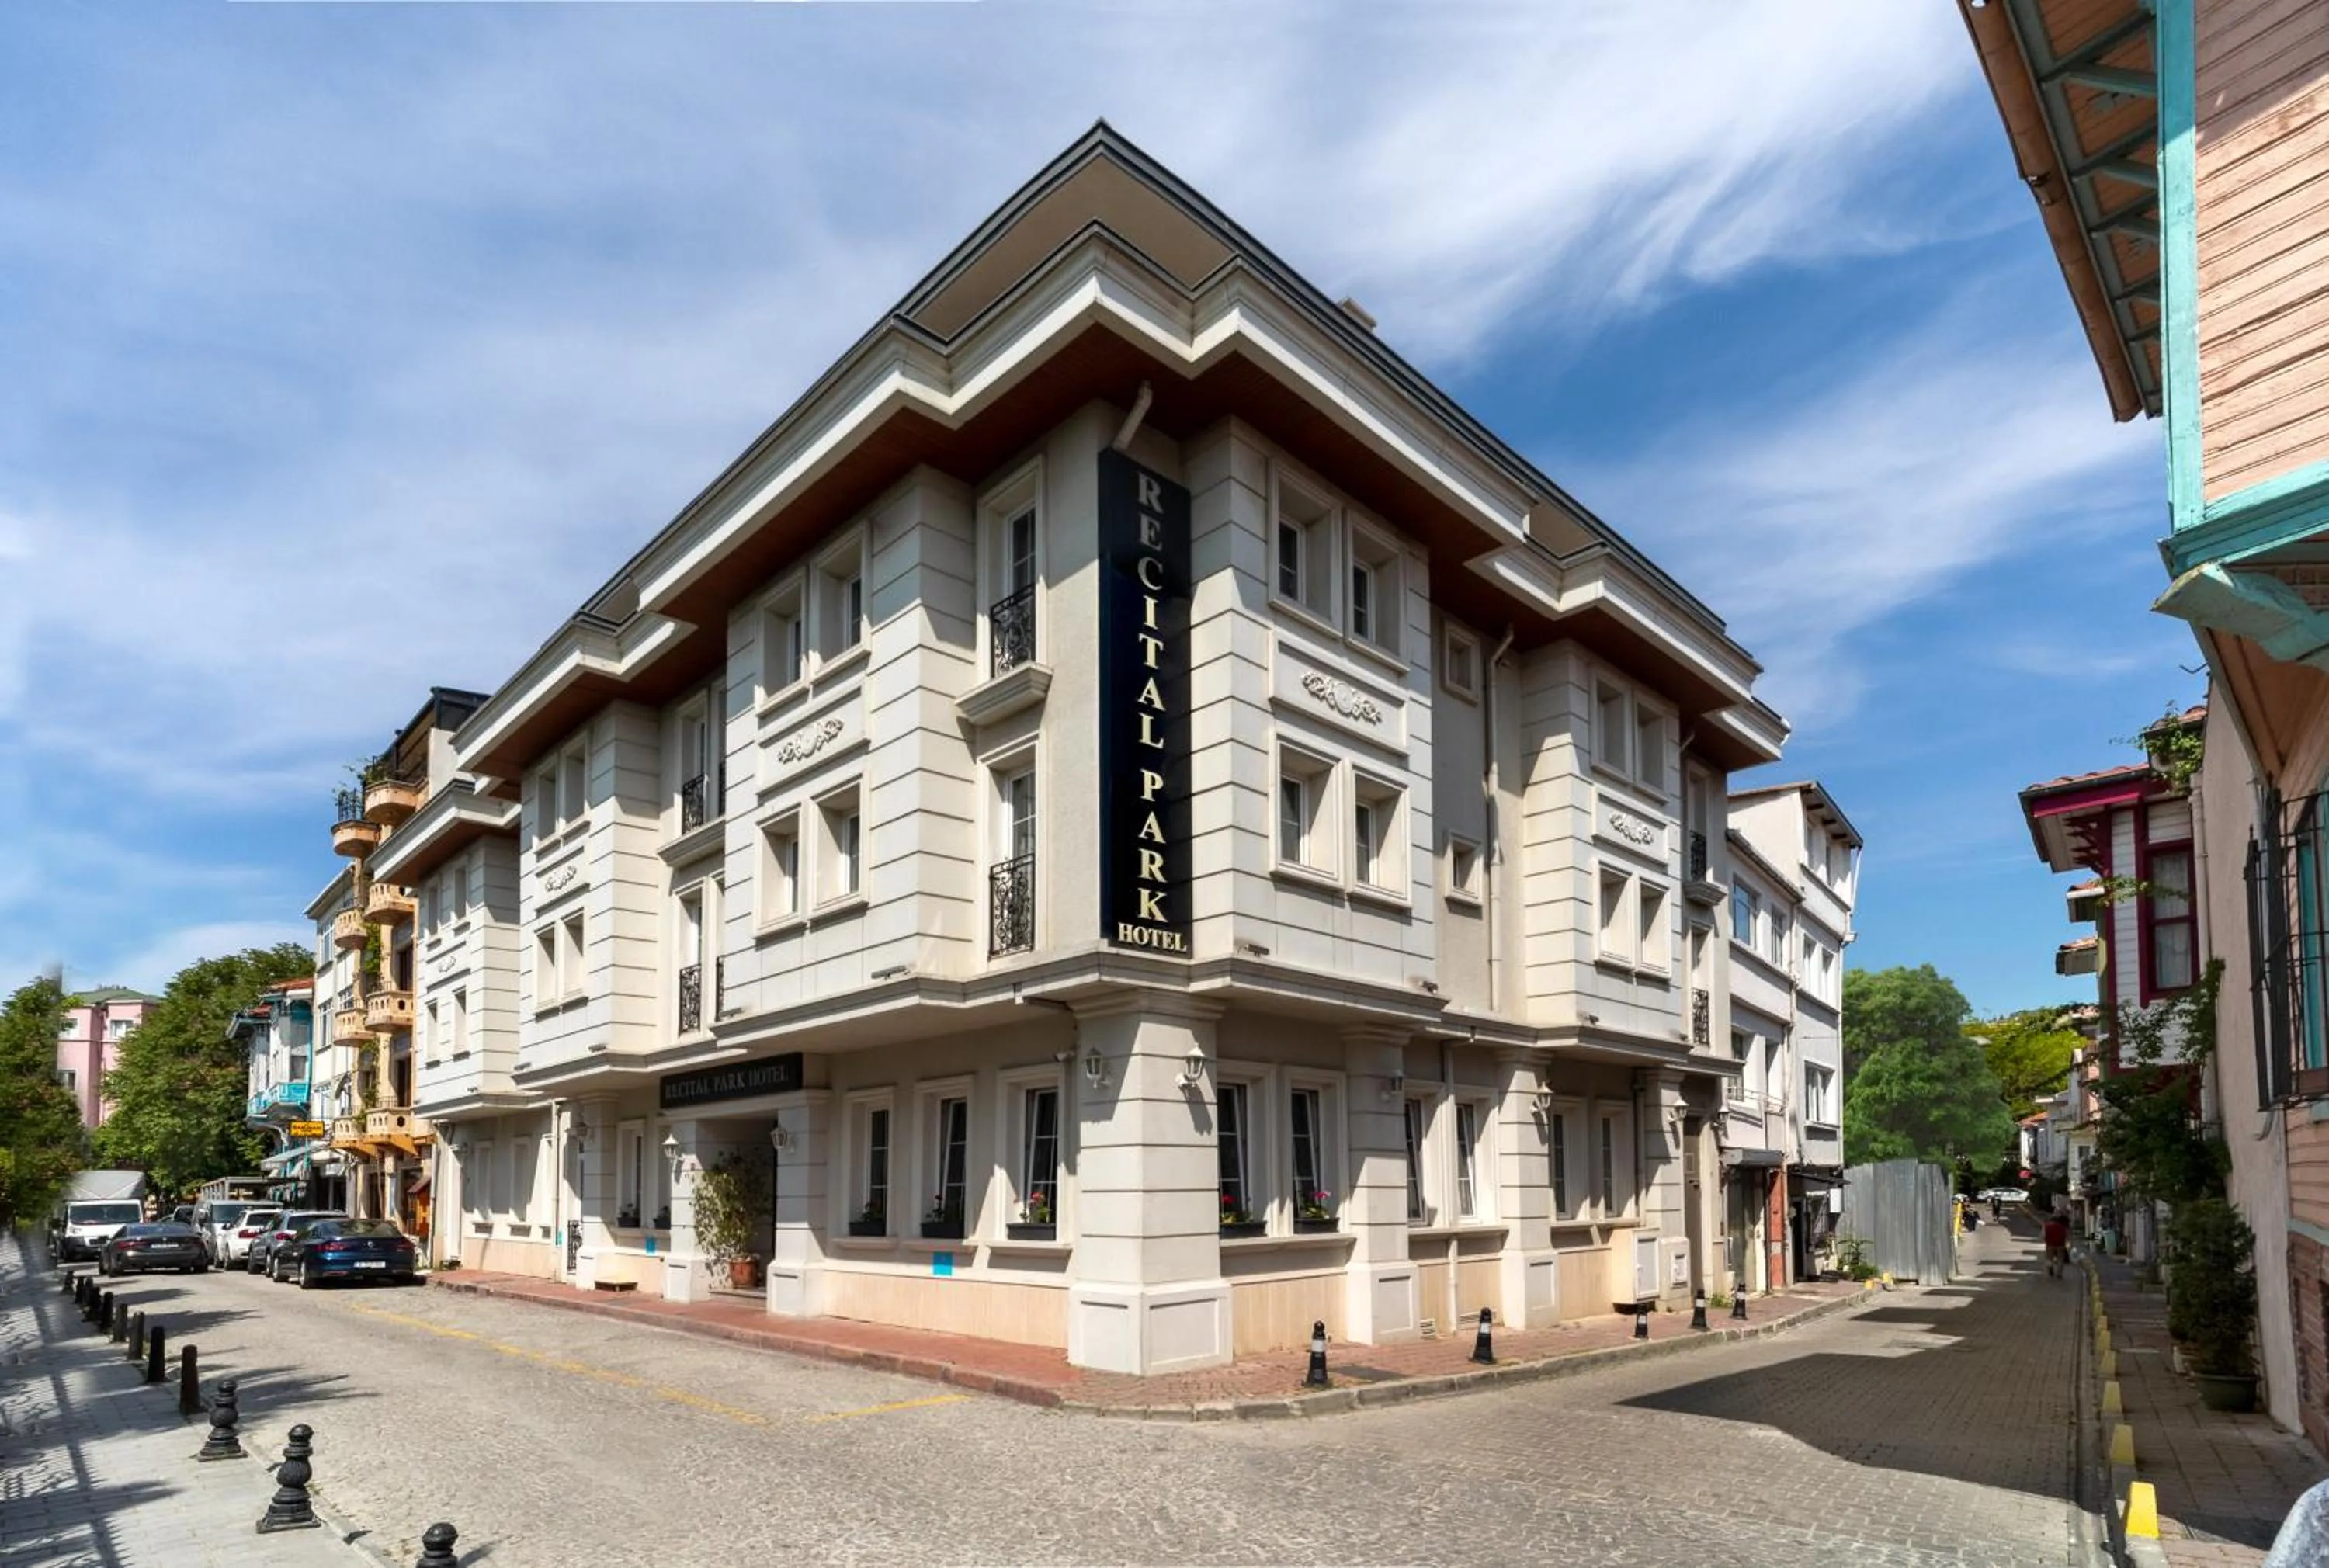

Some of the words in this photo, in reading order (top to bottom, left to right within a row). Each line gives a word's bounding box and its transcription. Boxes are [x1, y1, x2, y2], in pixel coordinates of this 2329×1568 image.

[1137, 471, 1166, 750] RECITAL
[1137, 768, 1168, 923] PARK
[1118, 922, 1187, 952] HOTEL
[665, 1077, 709, 1099] RECITAL
[713, 1071, 745, 1092] PARK
[748, 1064, 789, 1087] HOTEL
